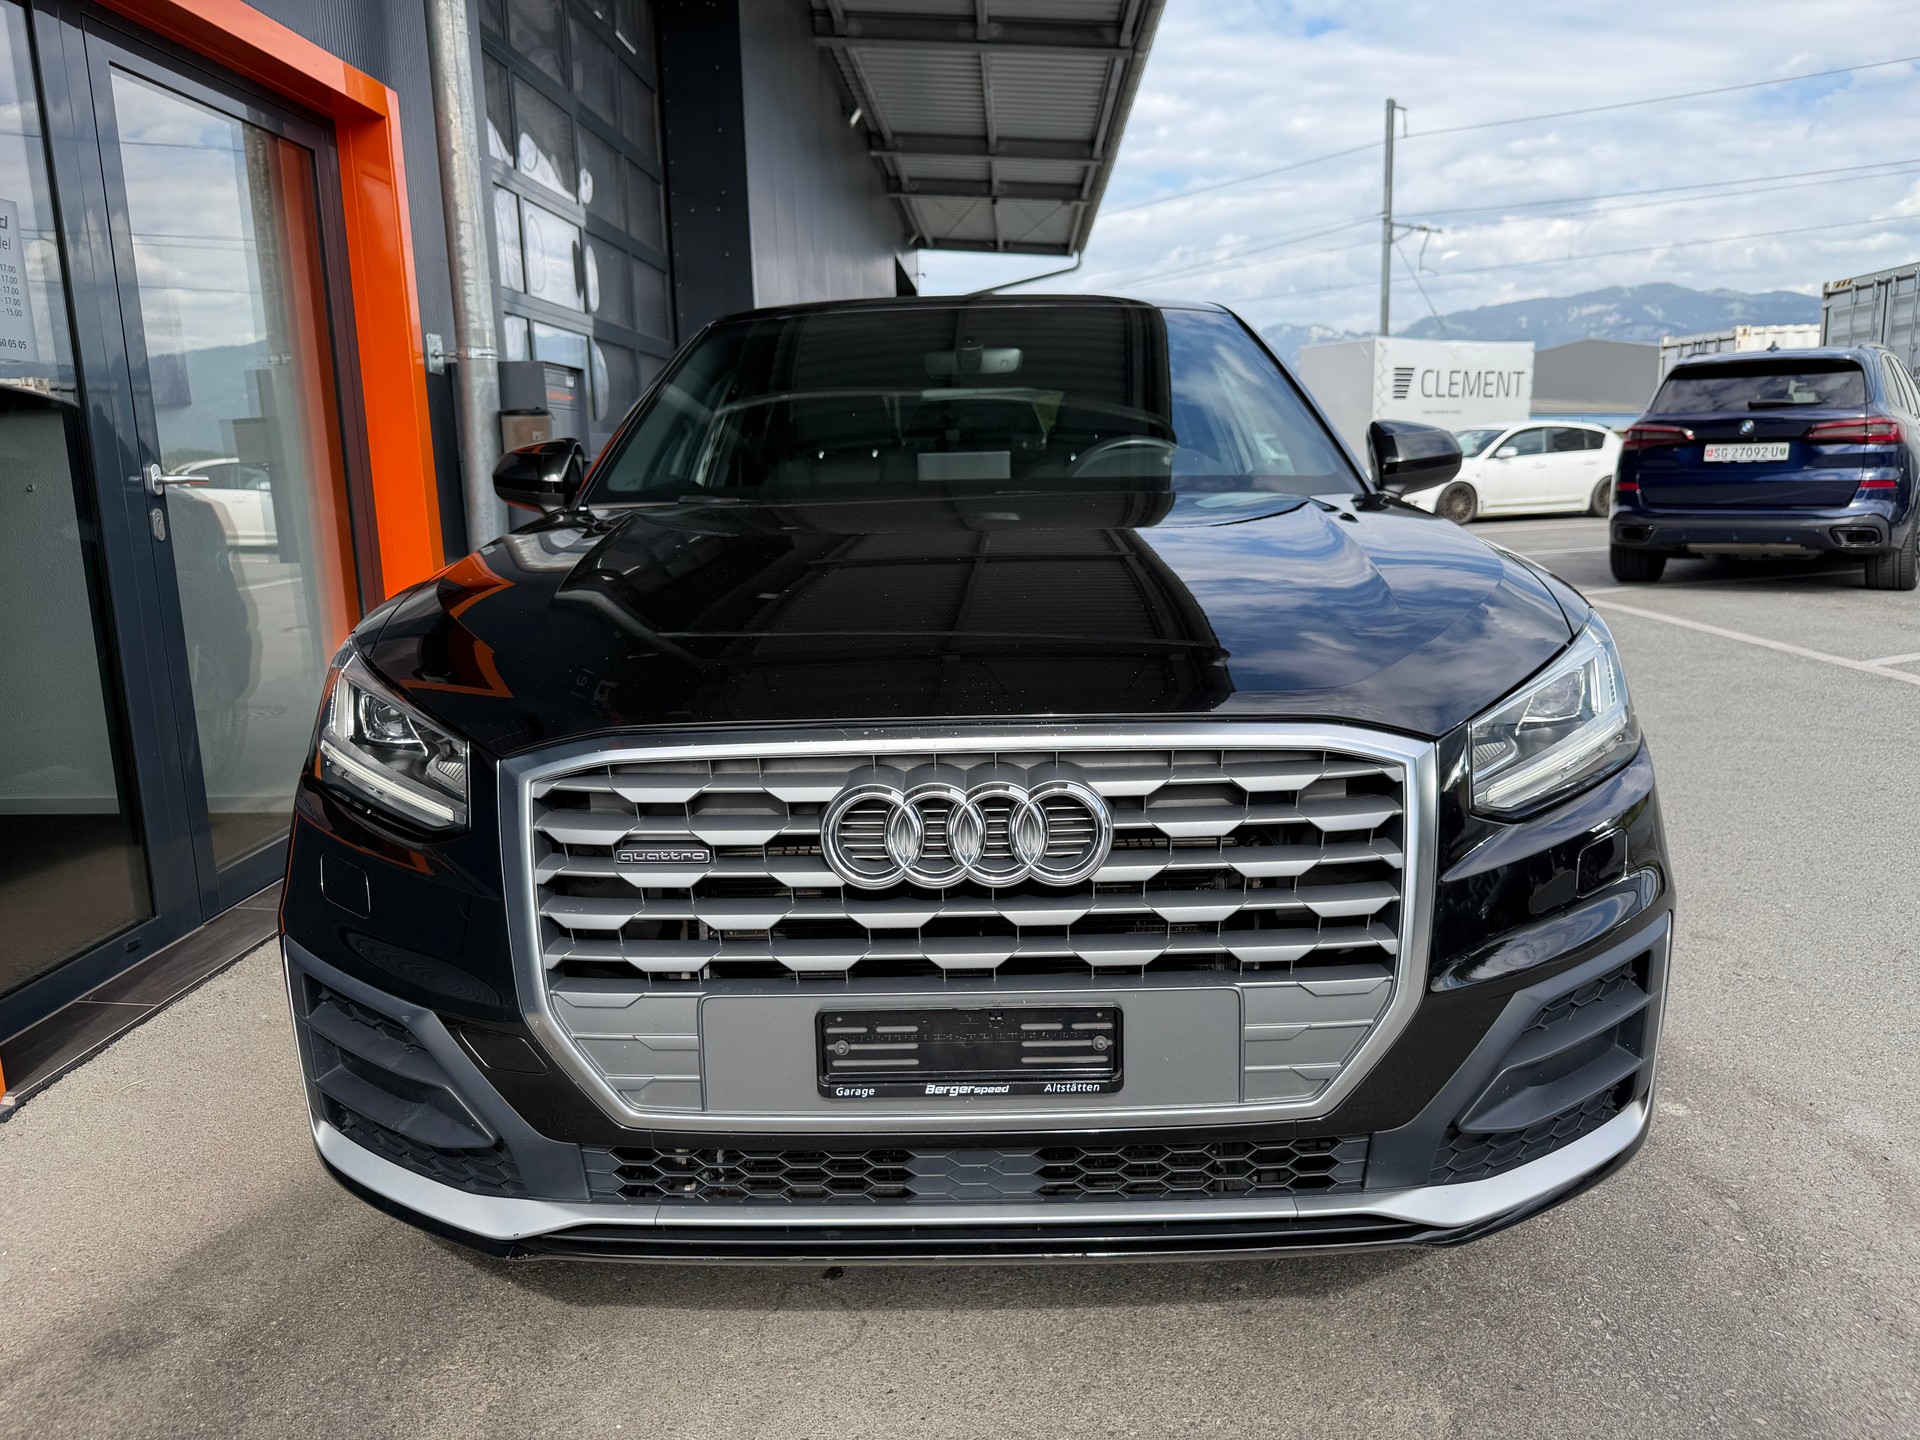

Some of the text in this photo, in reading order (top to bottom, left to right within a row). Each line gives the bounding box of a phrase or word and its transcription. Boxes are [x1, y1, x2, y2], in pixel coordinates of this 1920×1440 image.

[1, 274, 17, 284] 17.00
[3, 286, 19, 296] 17.00
[4, 297, 21, 306] 17.00
[6, 308, 23, 317] 15.00
[8, 339, 17, 348] 05
[18, 340, 27, 349] 05
[1420, 369, 1525, 398] CLEMENT
[1714, 446, 1779, 458] SG 27092 U
[620, 851, 705, 862] quattro
[835, 1082, 1100, 1098] Garage Bergerspeed Altstätten
